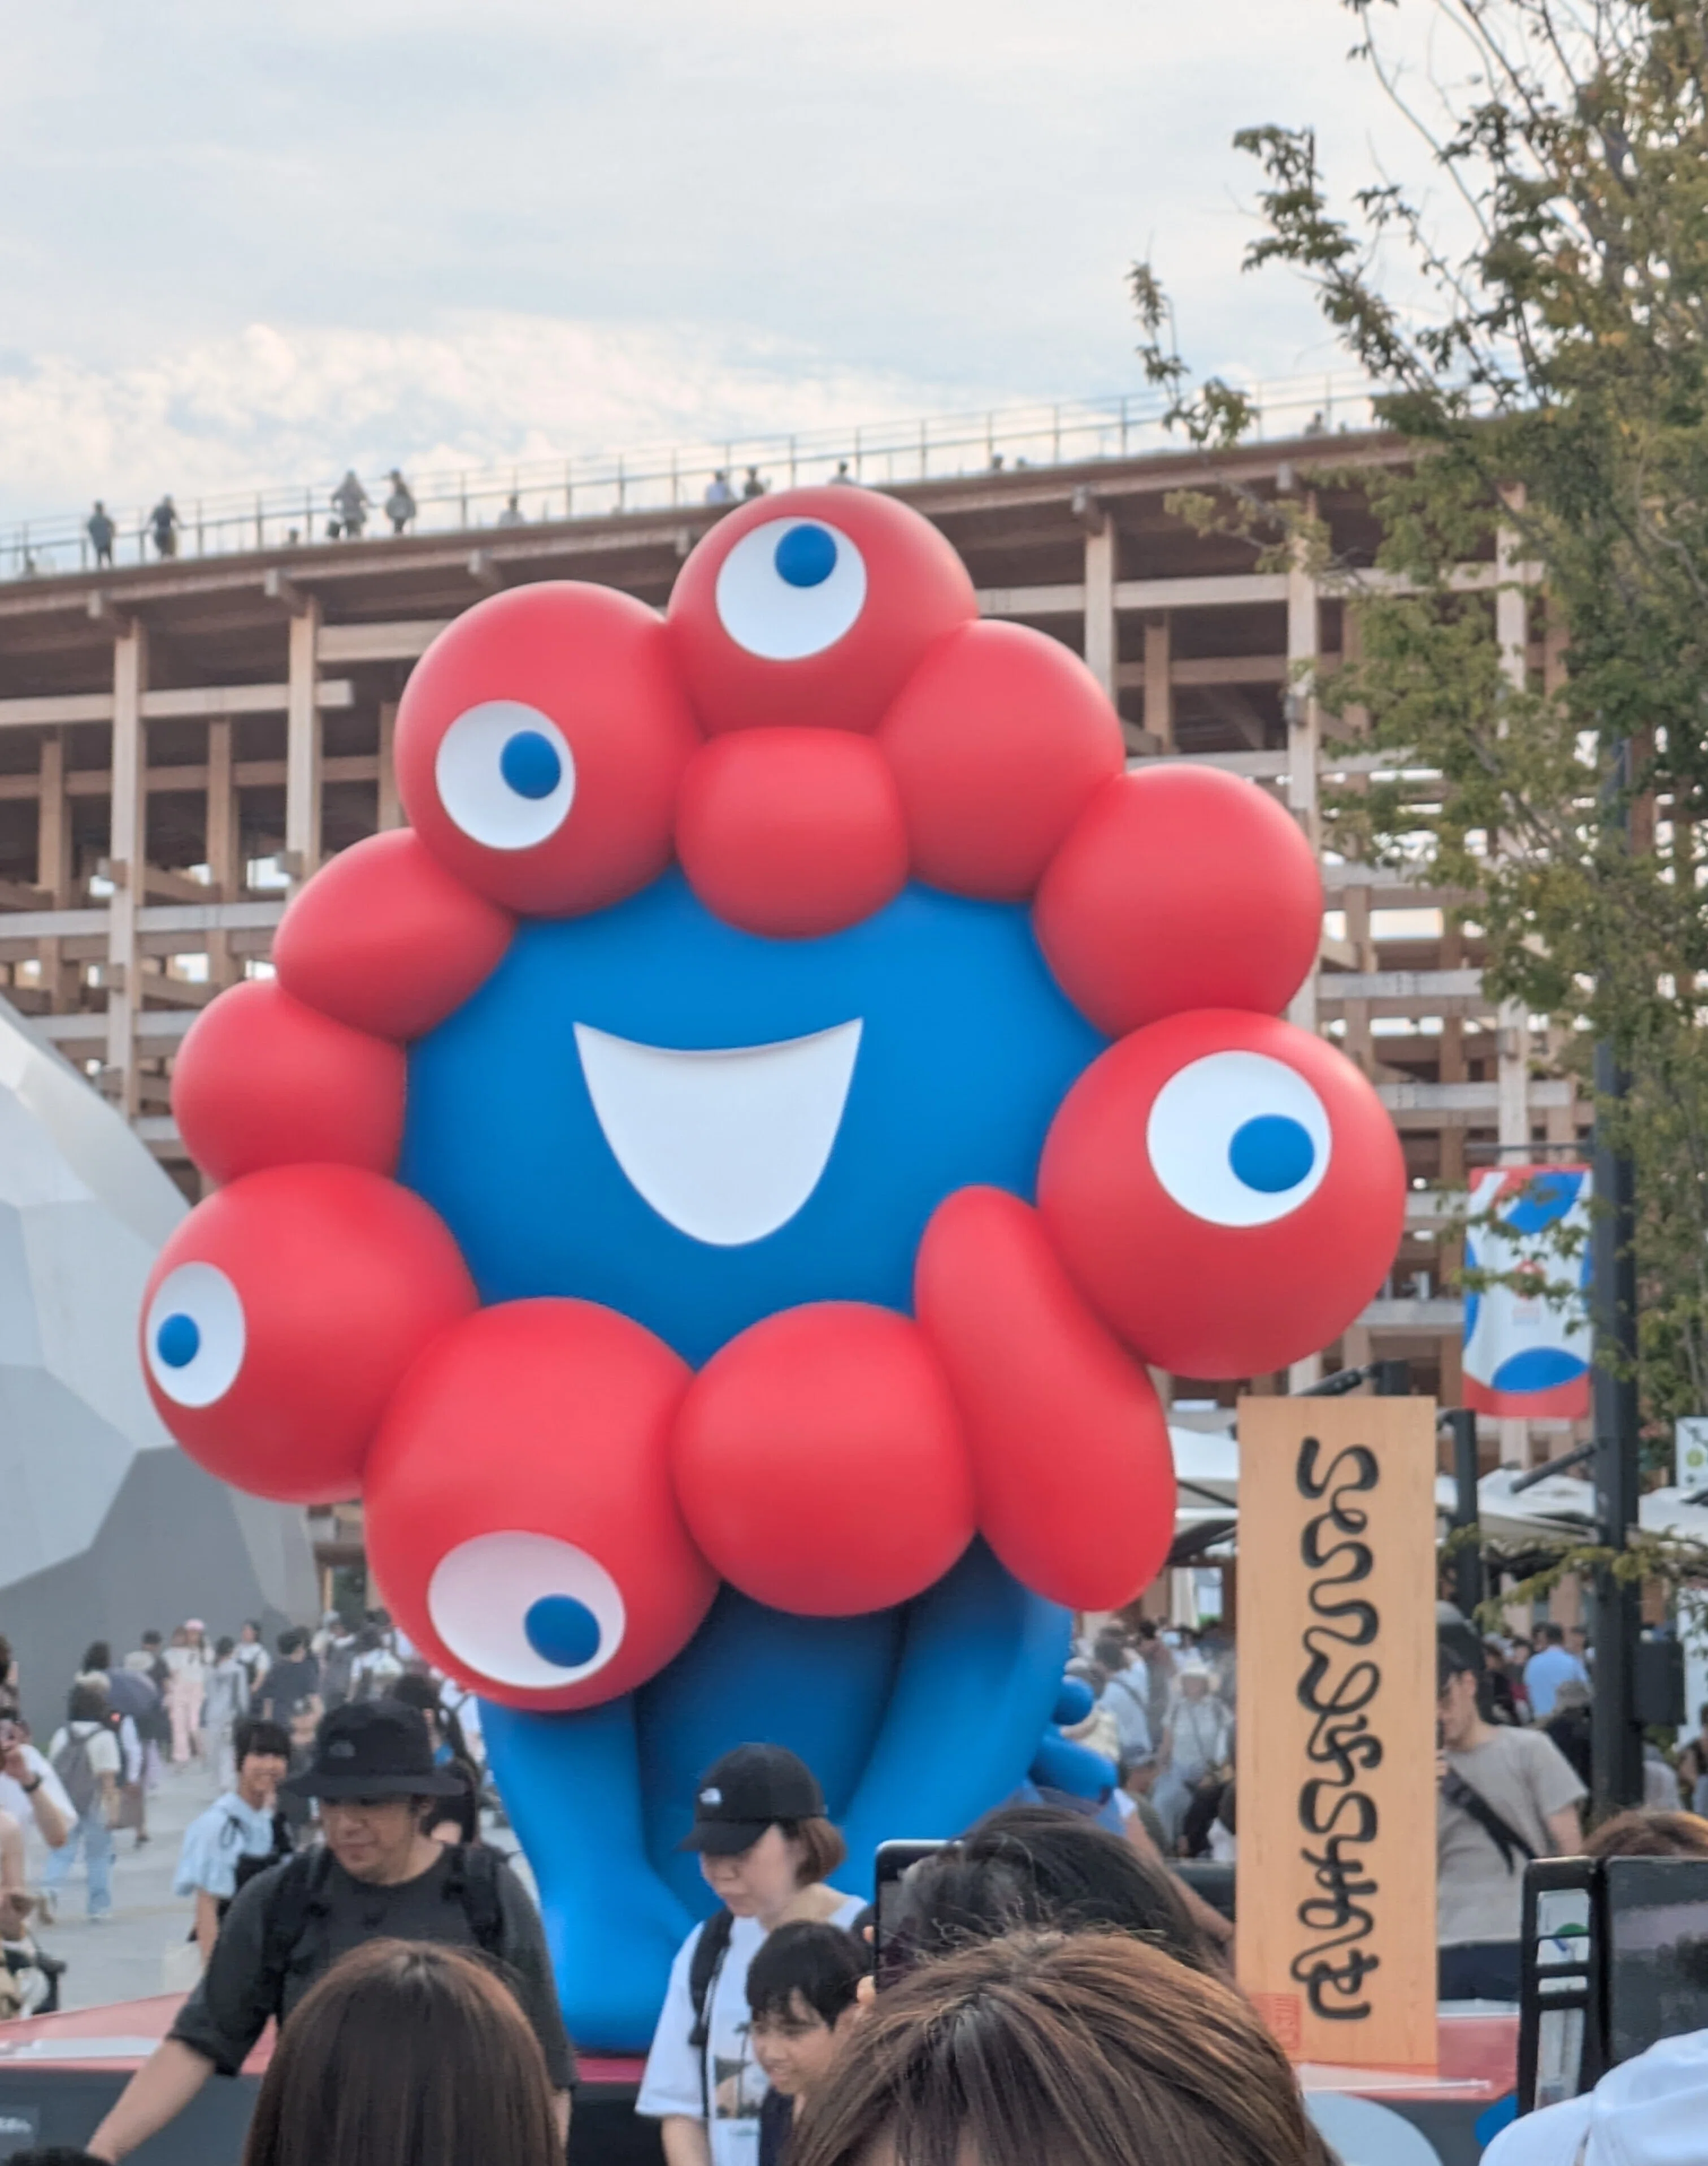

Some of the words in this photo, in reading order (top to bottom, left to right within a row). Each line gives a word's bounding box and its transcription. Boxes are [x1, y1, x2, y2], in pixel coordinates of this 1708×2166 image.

[1290, 1436, 1383, 2020] いらっしゃいませ
